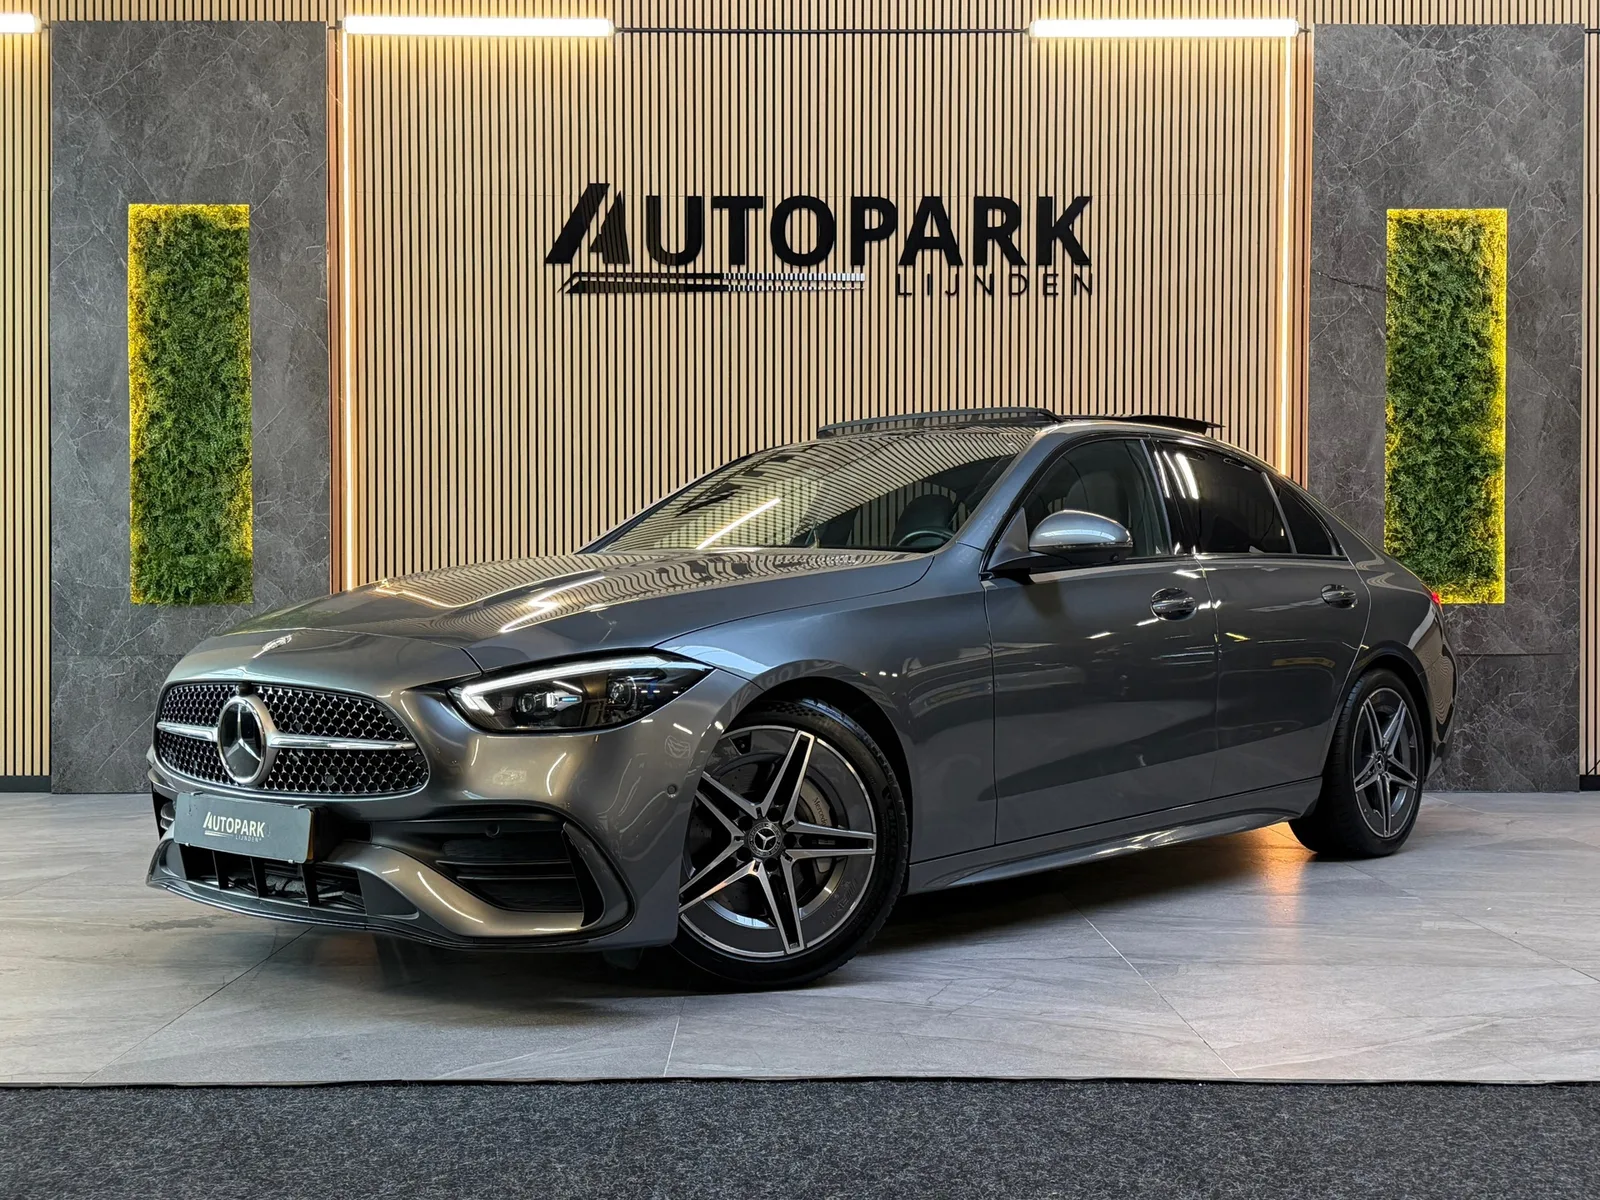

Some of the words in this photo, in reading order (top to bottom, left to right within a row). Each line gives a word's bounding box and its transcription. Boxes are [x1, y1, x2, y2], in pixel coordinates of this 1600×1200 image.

[545, 183, 1092, 266] AUTOPARK
[895, 273, 1094, 297] LIJNDEN
[203, 811, 266, 838] AUTOPARK
